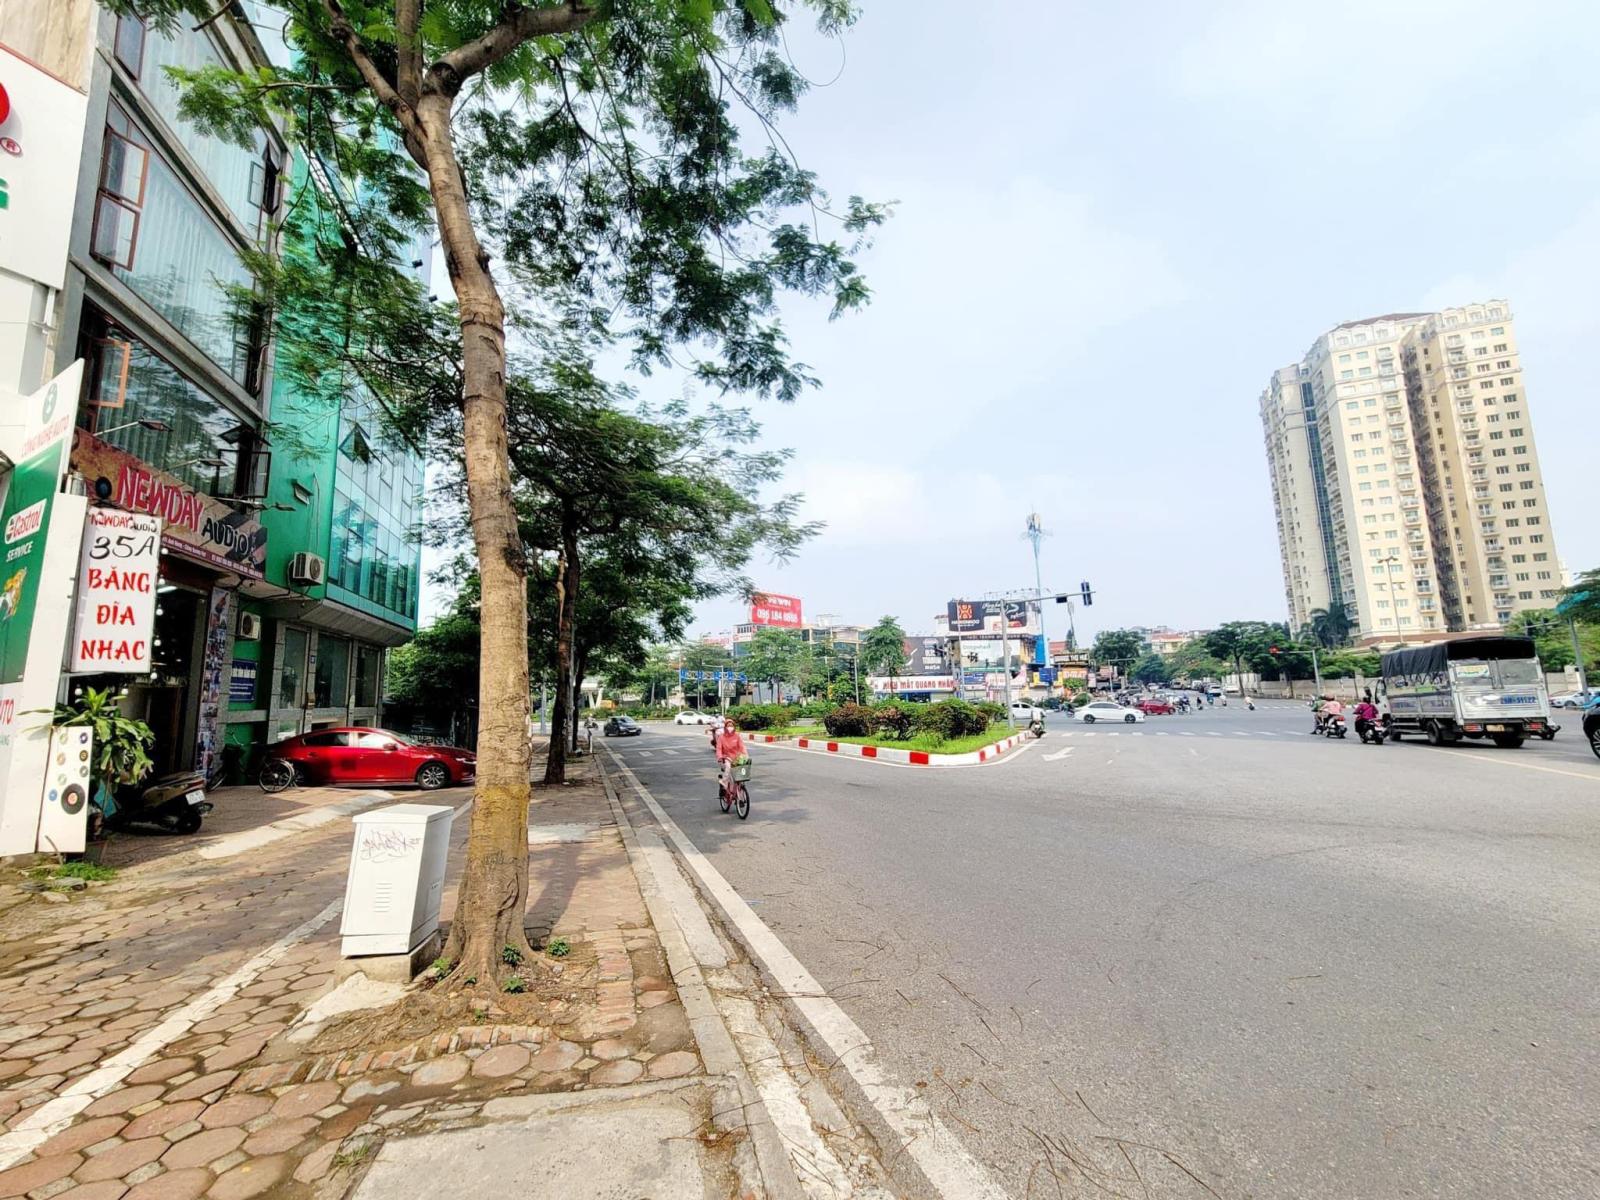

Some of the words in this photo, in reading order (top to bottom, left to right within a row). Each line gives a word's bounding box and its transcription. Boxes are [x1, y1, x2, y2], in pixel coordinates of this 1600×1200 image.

[116, 465, 204, 532] NEWDAY
[89, 535, 155, 560] 35A
[88, 566, 150, 594] BĂNG
[96, 600, 136, 626] ĐĨA
[81, 639, 145, 664] NHẠC
